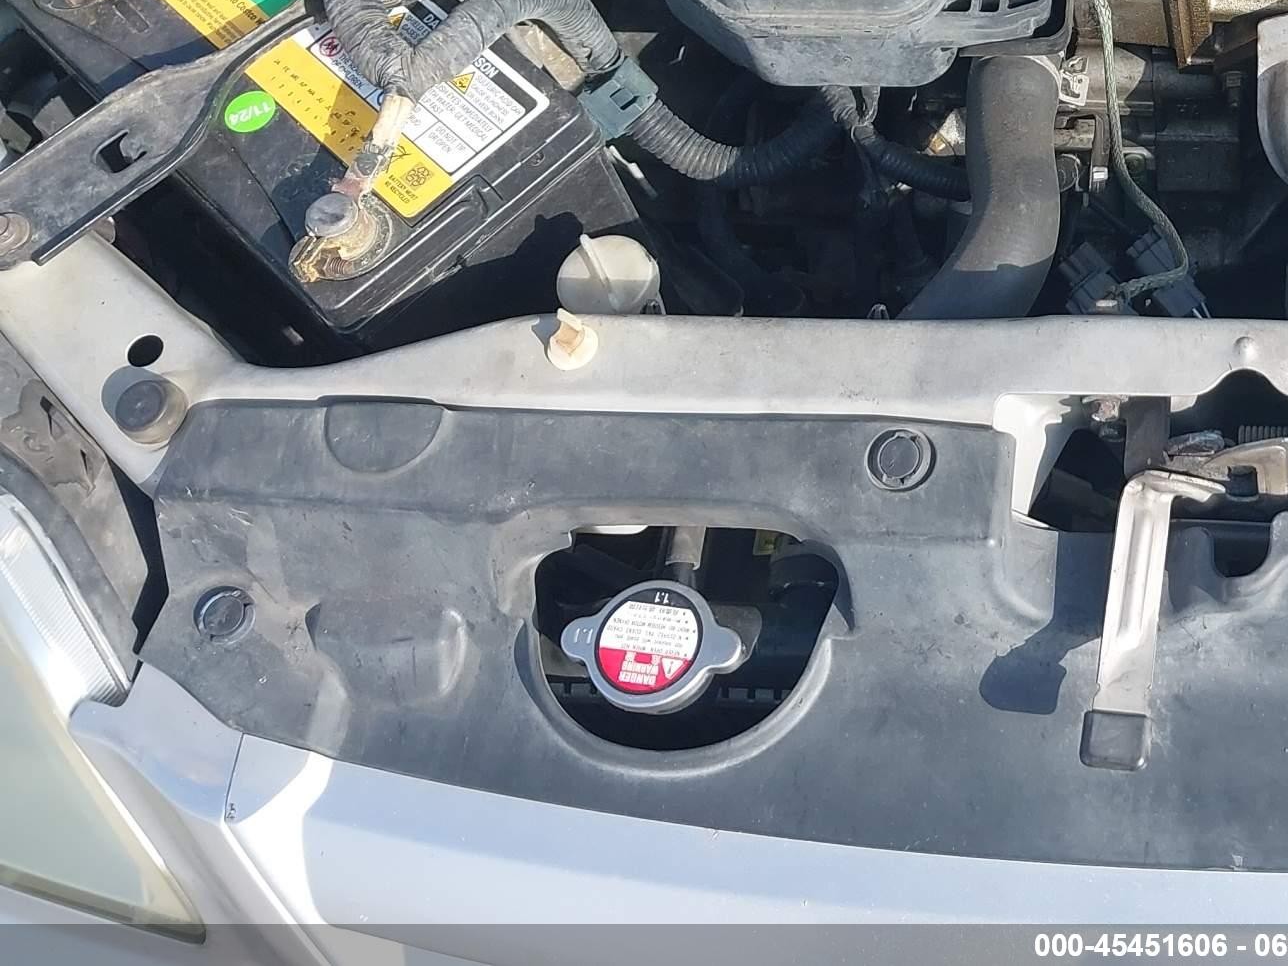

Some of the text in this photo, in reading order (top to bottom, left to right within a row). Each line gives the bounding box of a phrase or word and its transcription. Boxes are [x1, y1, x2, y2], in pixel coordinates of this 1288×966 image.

[234, 0, 259, 21] Costco
[654, 591, 669, 603] 1.1
[621, 661, 658, 674] WARNING
[618, 670, 656, 686] DANGER
